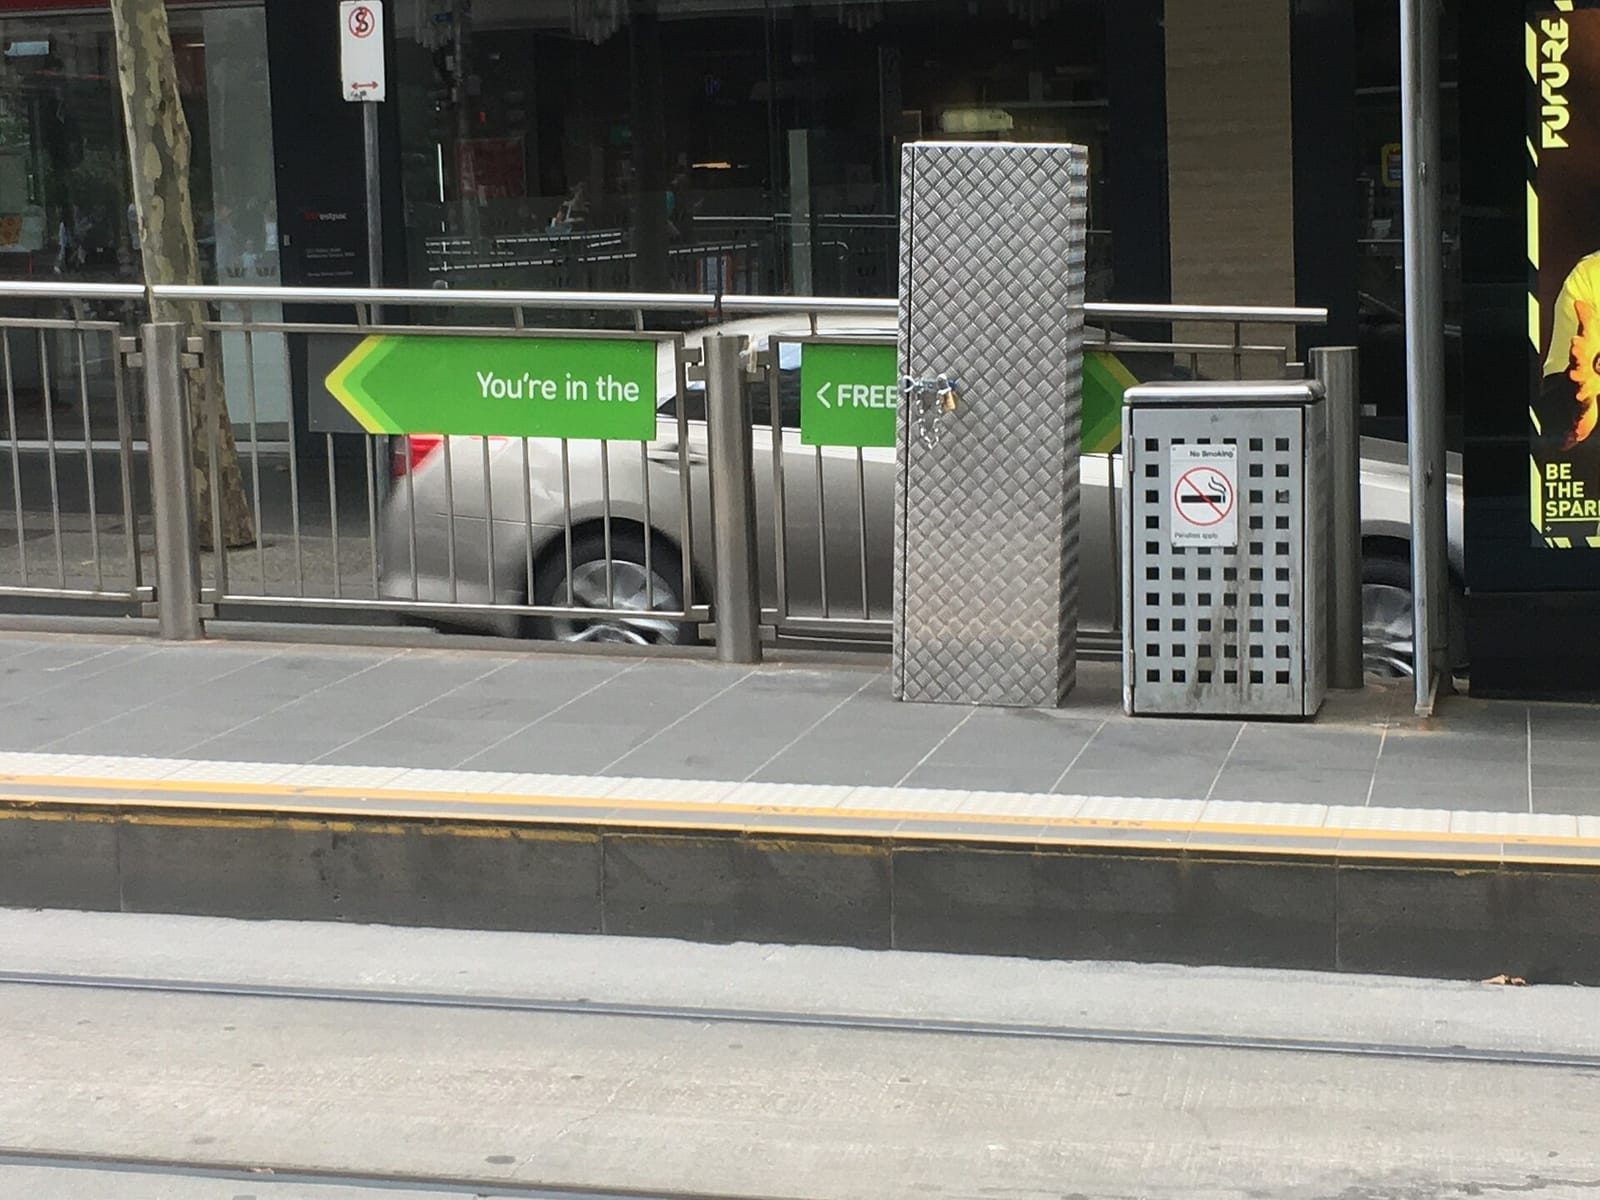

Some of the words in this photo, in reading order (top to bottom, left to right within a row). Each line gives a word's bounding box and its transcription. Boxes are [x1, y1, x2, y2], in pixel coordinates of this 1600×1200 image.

[1541, 18, 1570, 148] FUTURE
[476, 371, 557, 400] You're
[566, 372, 588, 401] in
[596, 374, 640, 402] the
[837, 384, 897, 408] FREE
[1189, 450, 1201, 458] No
[1202, 450, 1234, 459] Smoking
[1546, 463, 1572, 480] BE
[1545, 481, 1584, 499] THE
[1545, 500, 1600, 517] SPAR
